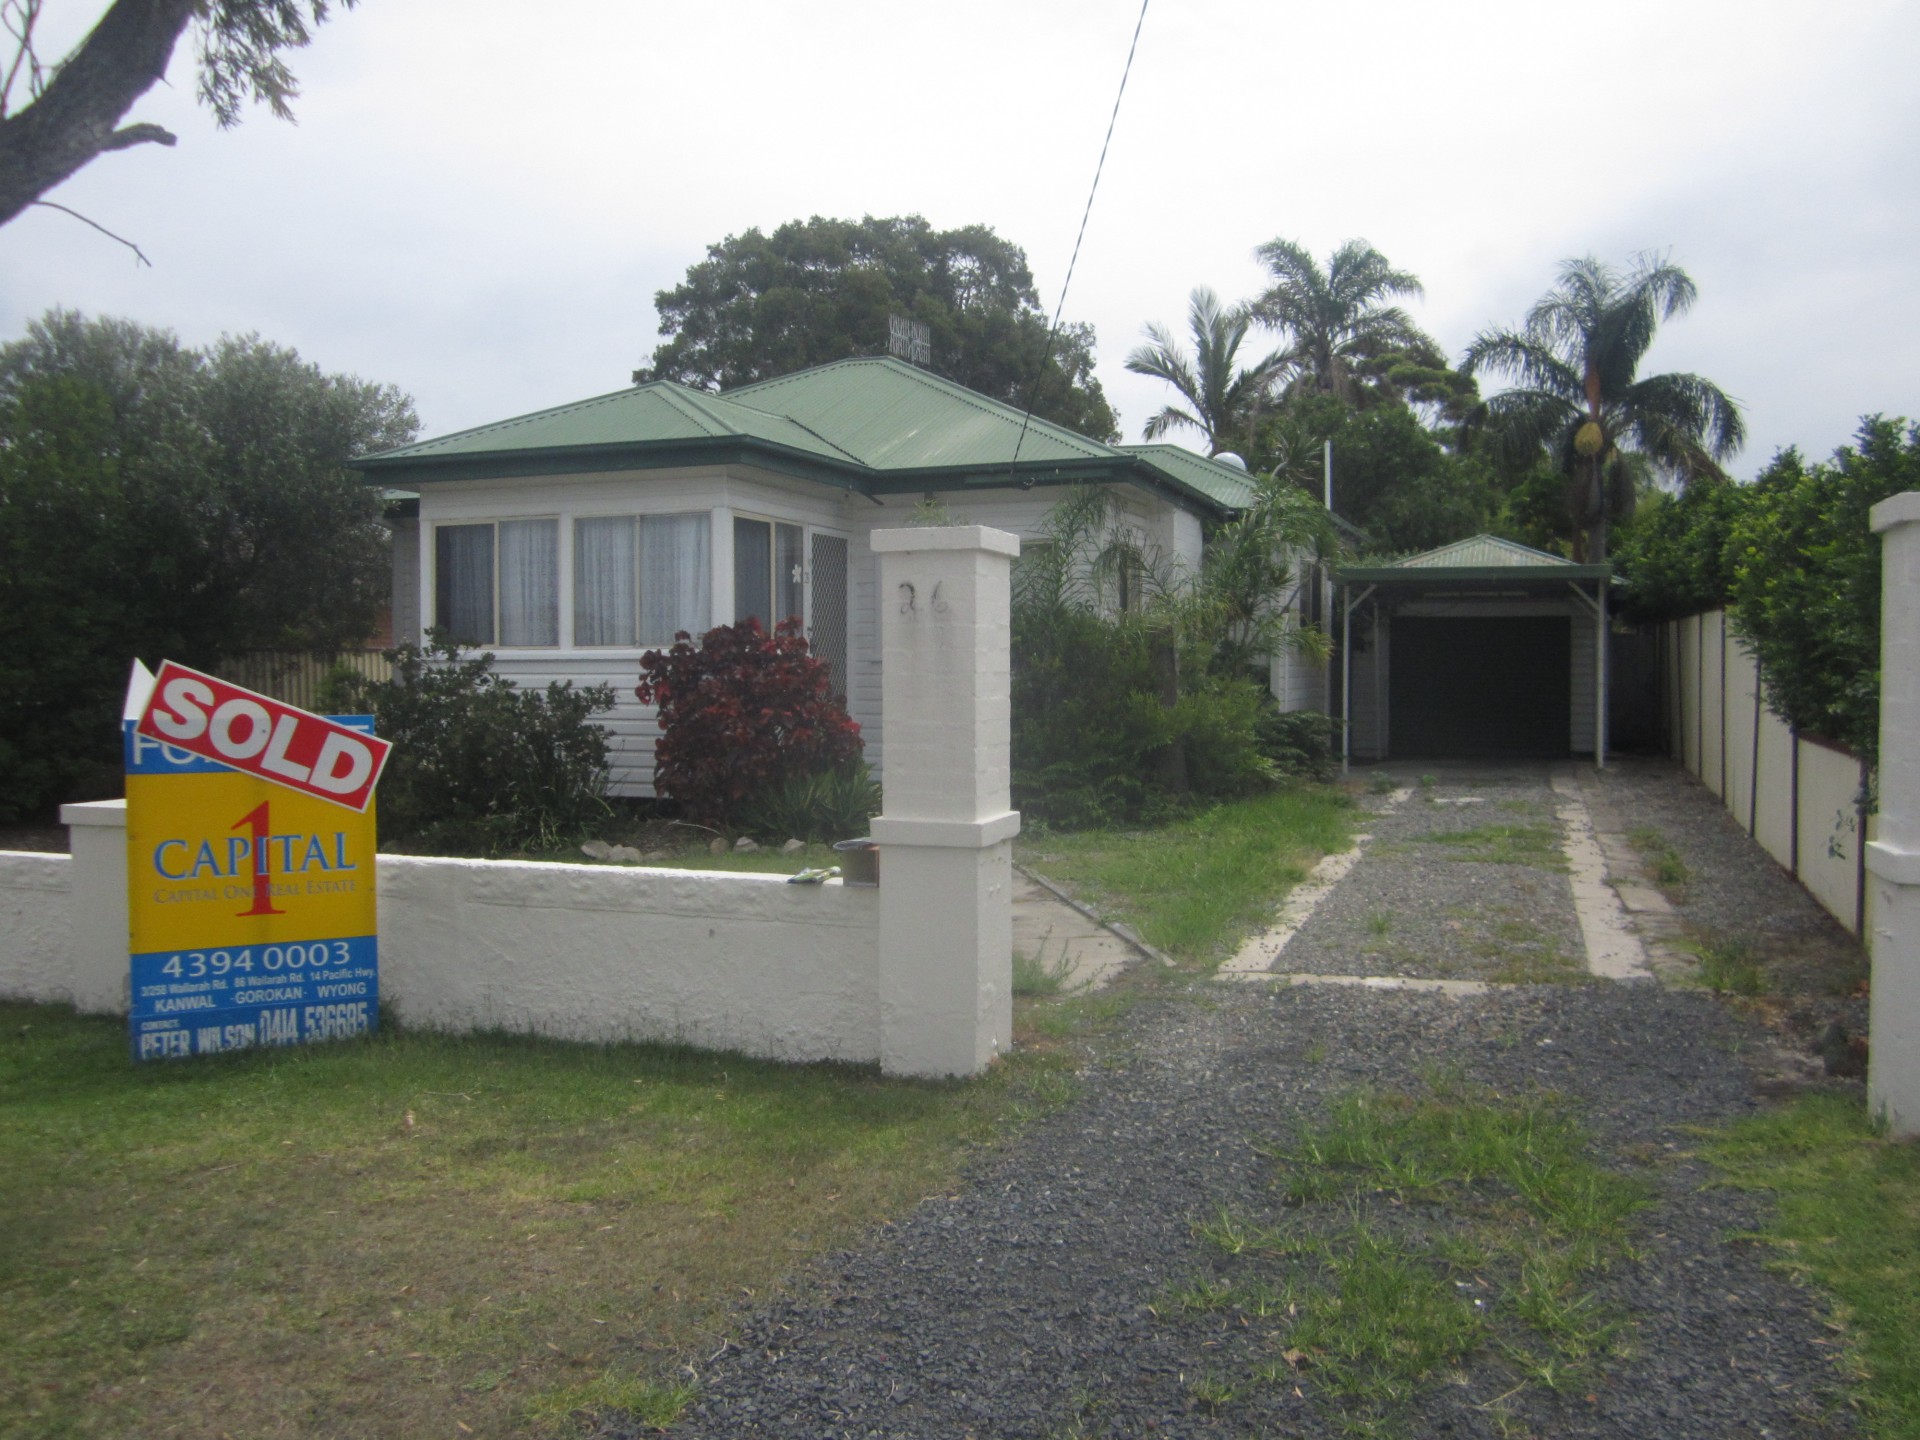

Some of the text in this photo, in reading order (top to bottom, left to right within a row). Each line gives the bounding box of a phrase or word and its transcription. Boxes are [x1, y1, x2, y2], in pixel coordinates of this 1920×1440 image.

[152, 677, 373, 795] SOLD
[153, 832, 357, 880] CAPITAL
[153, 888, 218, 904] CAPITAL
[264, 882, 300, 897] REAL
[306, 879, 356, 894] ESTATE
[162, 942, 350, 978] 4394 0003
[289, 972, 305, 983] Rd.
[310, 972, 320, 981] 14
[322, 969, 353, 980] Pacific
[354, 967, 376, 979] Hwy.
[155, 982, 366, 1013] KANWAL GOROKAN WYONG
[141, 1030, 190, 1061] PETER
[197, 1024, 255, 1055] WILSON
[260, 1008, 298, 1046] 0414
